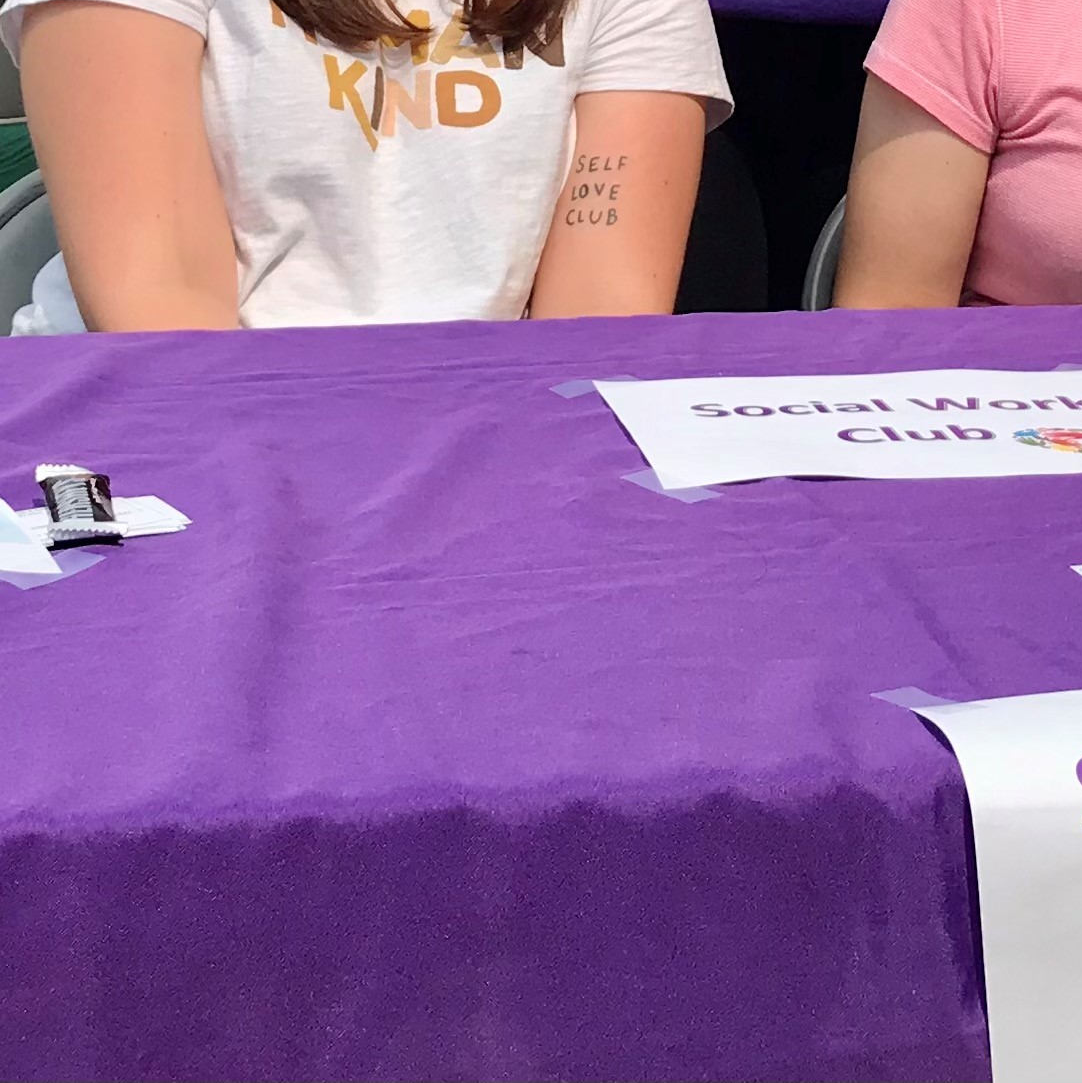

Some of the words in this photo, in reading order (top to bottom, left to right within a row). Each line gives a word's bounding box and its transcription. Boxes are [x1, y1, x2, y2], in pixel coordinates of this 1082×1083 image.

[323, 53, 502, 152] KIND
[575, 154, 628, 174] SELF
[571, 182, 621, 201] LOVE
[565, 207, 618, 226] CLUB
[690, 398, 895, 417] Social
[837, 424, 997, 444] Club
